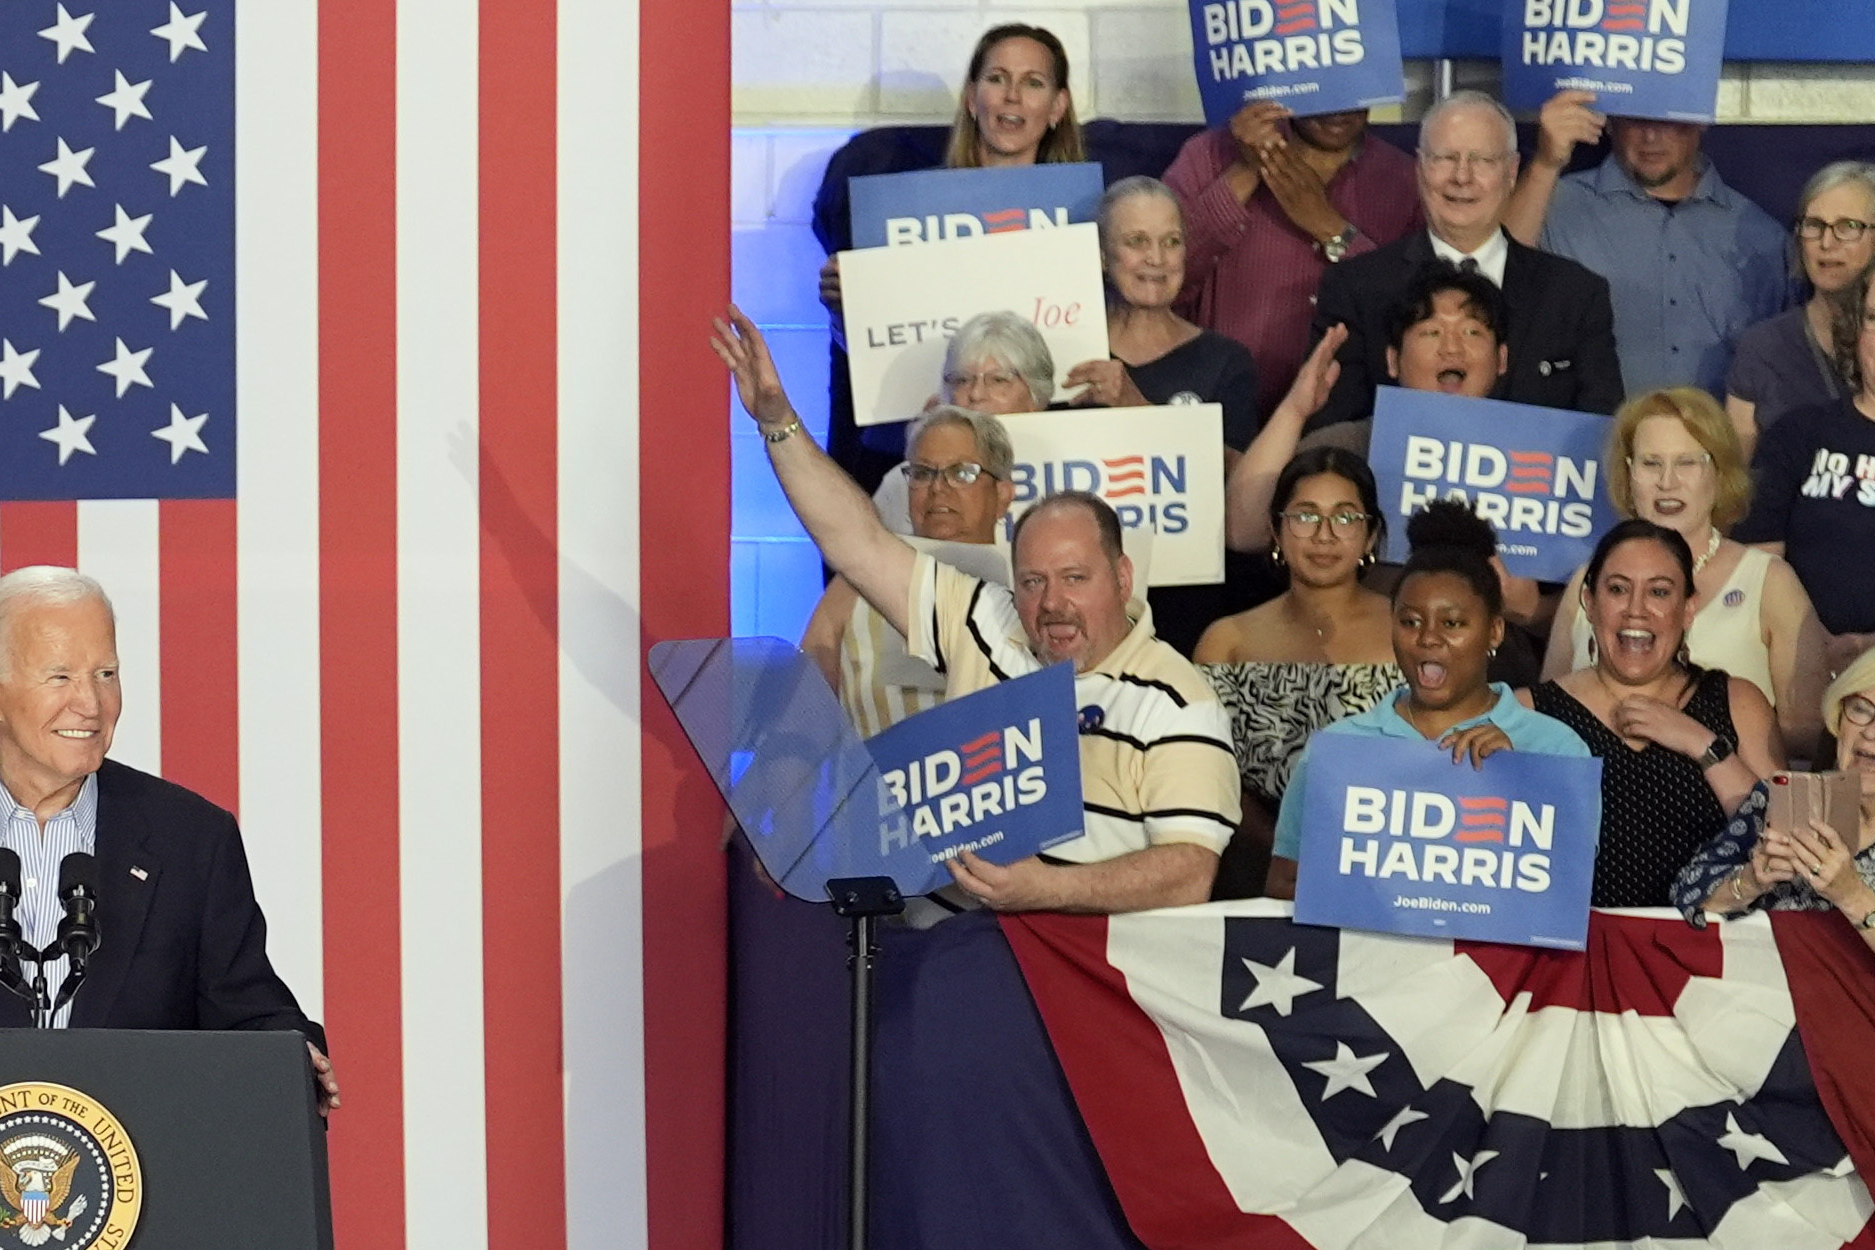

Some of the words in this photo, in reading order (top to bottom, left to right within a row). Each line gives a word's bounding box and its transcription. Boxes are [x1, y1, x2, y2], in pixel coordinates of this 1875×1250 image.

[1204, 0, 1359, 46] BIDEN
[1525, 0, 1690, 37] BIDEN
[1209, 29, 1365, 83] HARRIS
[1522, 31, 1687, 75] HARRIS
[867, 317, 959, 349] LET'S
[1012, 455, 1186, 502] BIDEN
[1404, 436, 1598, 500] BIDEN
[1801, 471, 1854, 500] MY
[1810, 448, 1850, 477] NO
[877, 718, 1043, 816] BIDEN
[880, 766, 1047, 856] HARRIS
[1343, 785, 1556, 851] BIDEN
[1339, 837, 1551, 893] HARRIS
[1394, 895, 1490, 915] JoeBiden.com
[38, 1093, 58, 1106] OF
[62, 1097, 88, 1119] THE
[92, 1117, 134, 1204] UNITED
